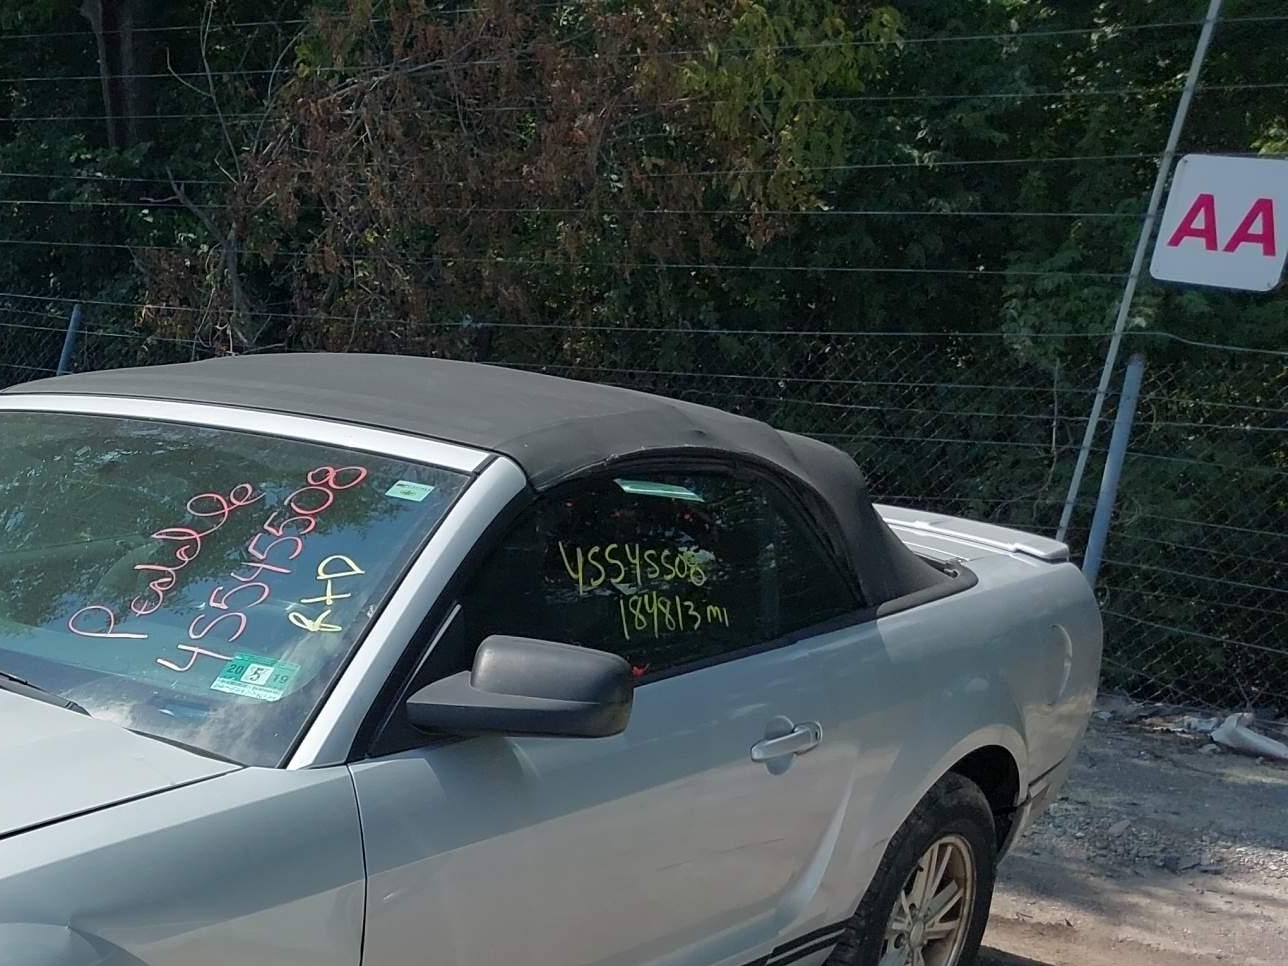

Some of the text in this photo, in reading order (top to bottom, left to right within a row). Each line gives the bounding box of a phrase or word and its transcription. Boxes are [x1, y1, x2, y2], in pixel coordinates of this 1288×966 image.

[1167, 193, 1277, 257] AA
[156, 465, 368, 673] 45545508
[288, 554, 366, 635] RXD
[558, 541, 707, 596] 45545508
[619, 590, 701, 641] 184813
[226, 663, 289, 684] 20 5 19
